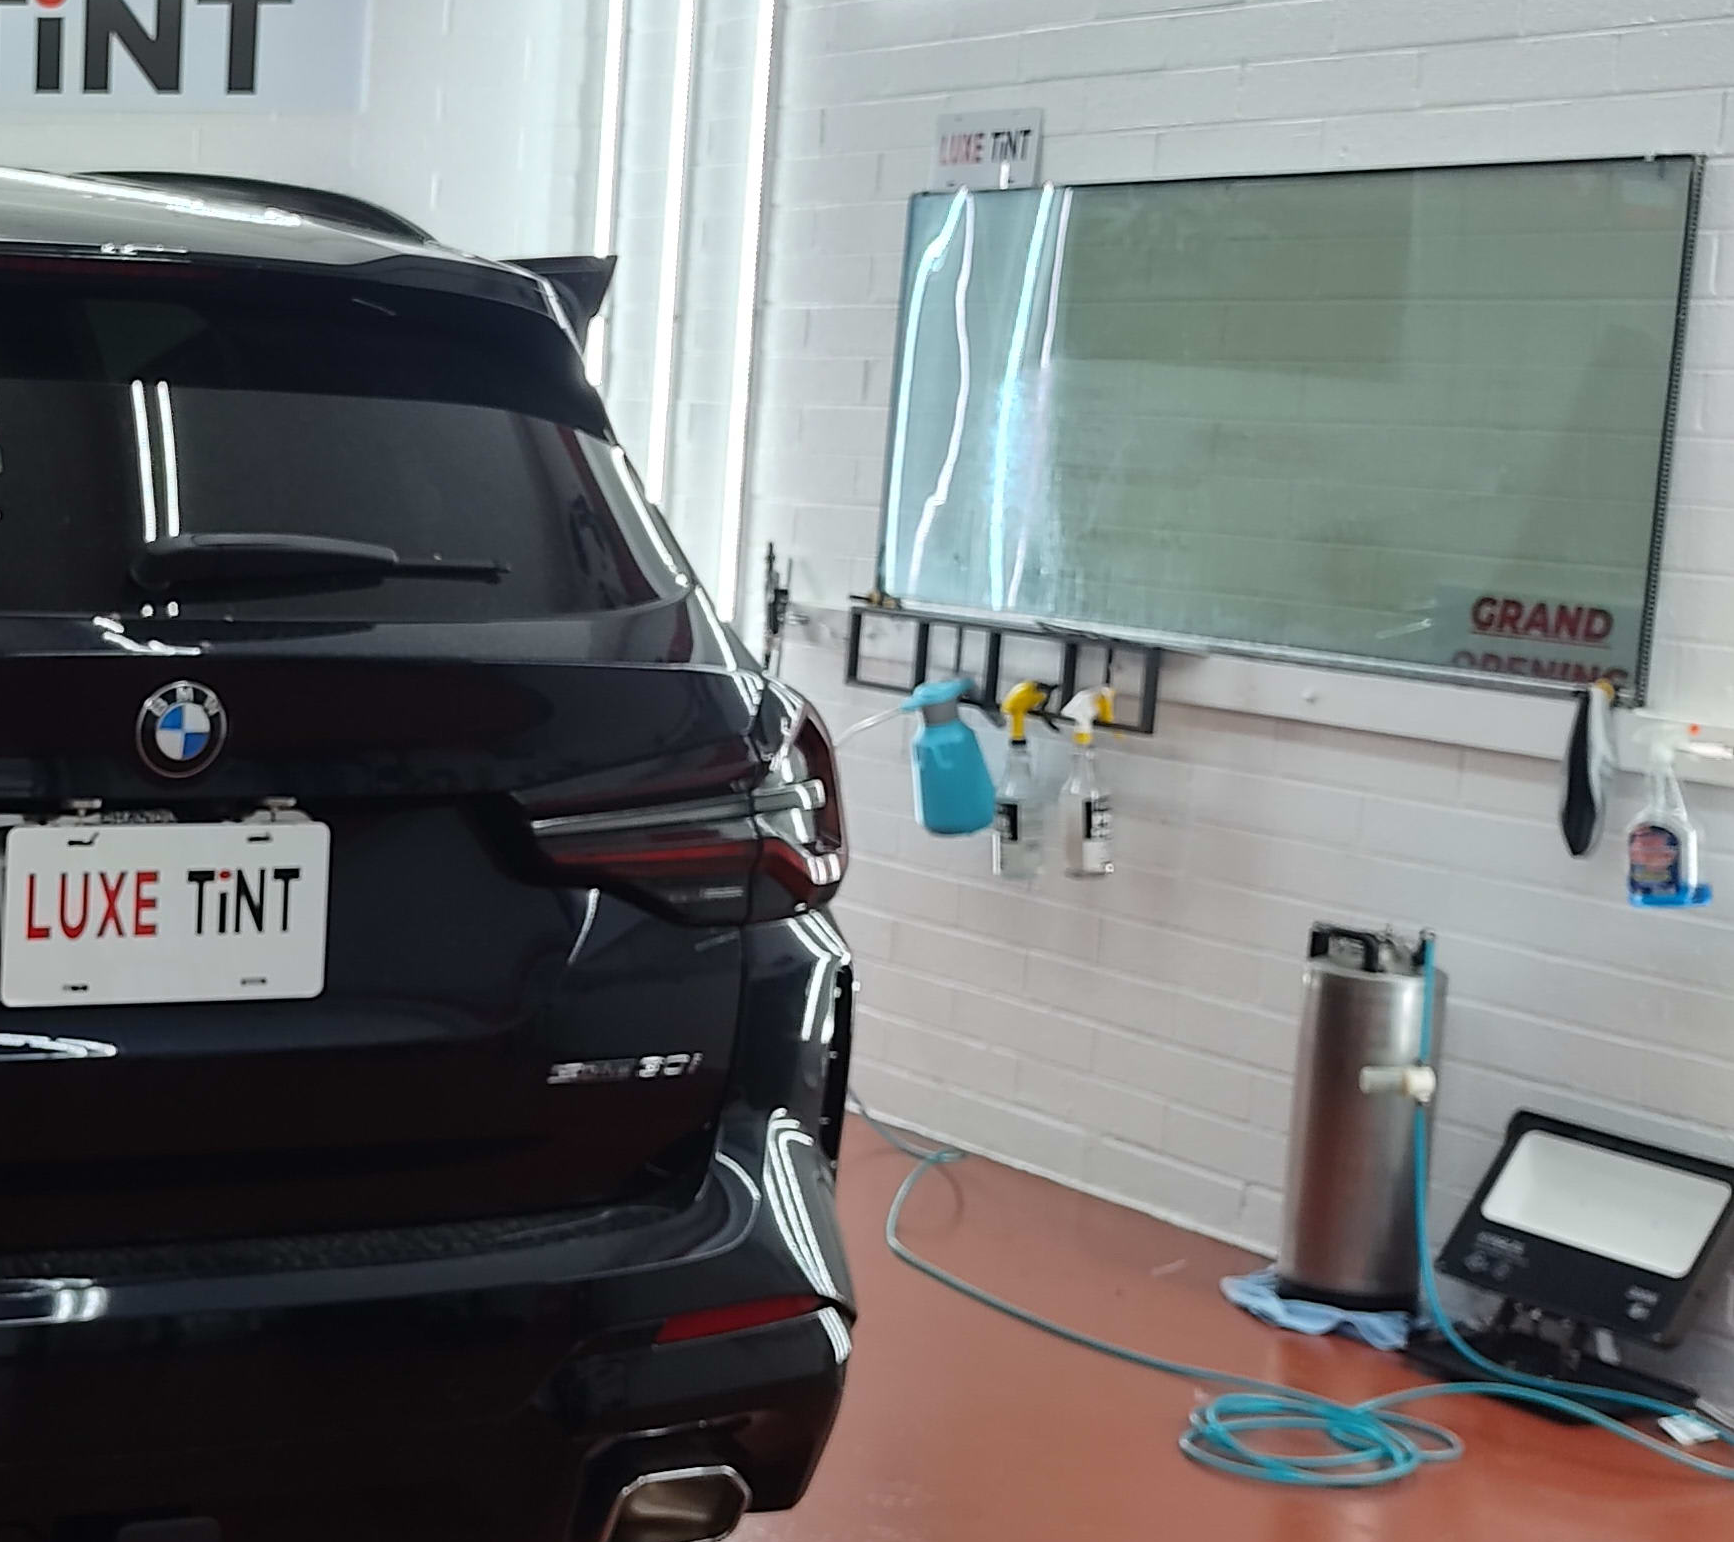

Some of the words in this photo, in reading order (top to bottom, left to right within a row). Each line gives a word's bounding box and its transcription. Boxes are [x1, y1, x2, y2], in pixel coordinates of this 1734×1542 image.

[1471, 596, 1614, 643] GRAND
[146, 686, 220, 718] BMW
[27, 871, 158, 939] LUXE
[187, 868, 300, 934] TiNT
